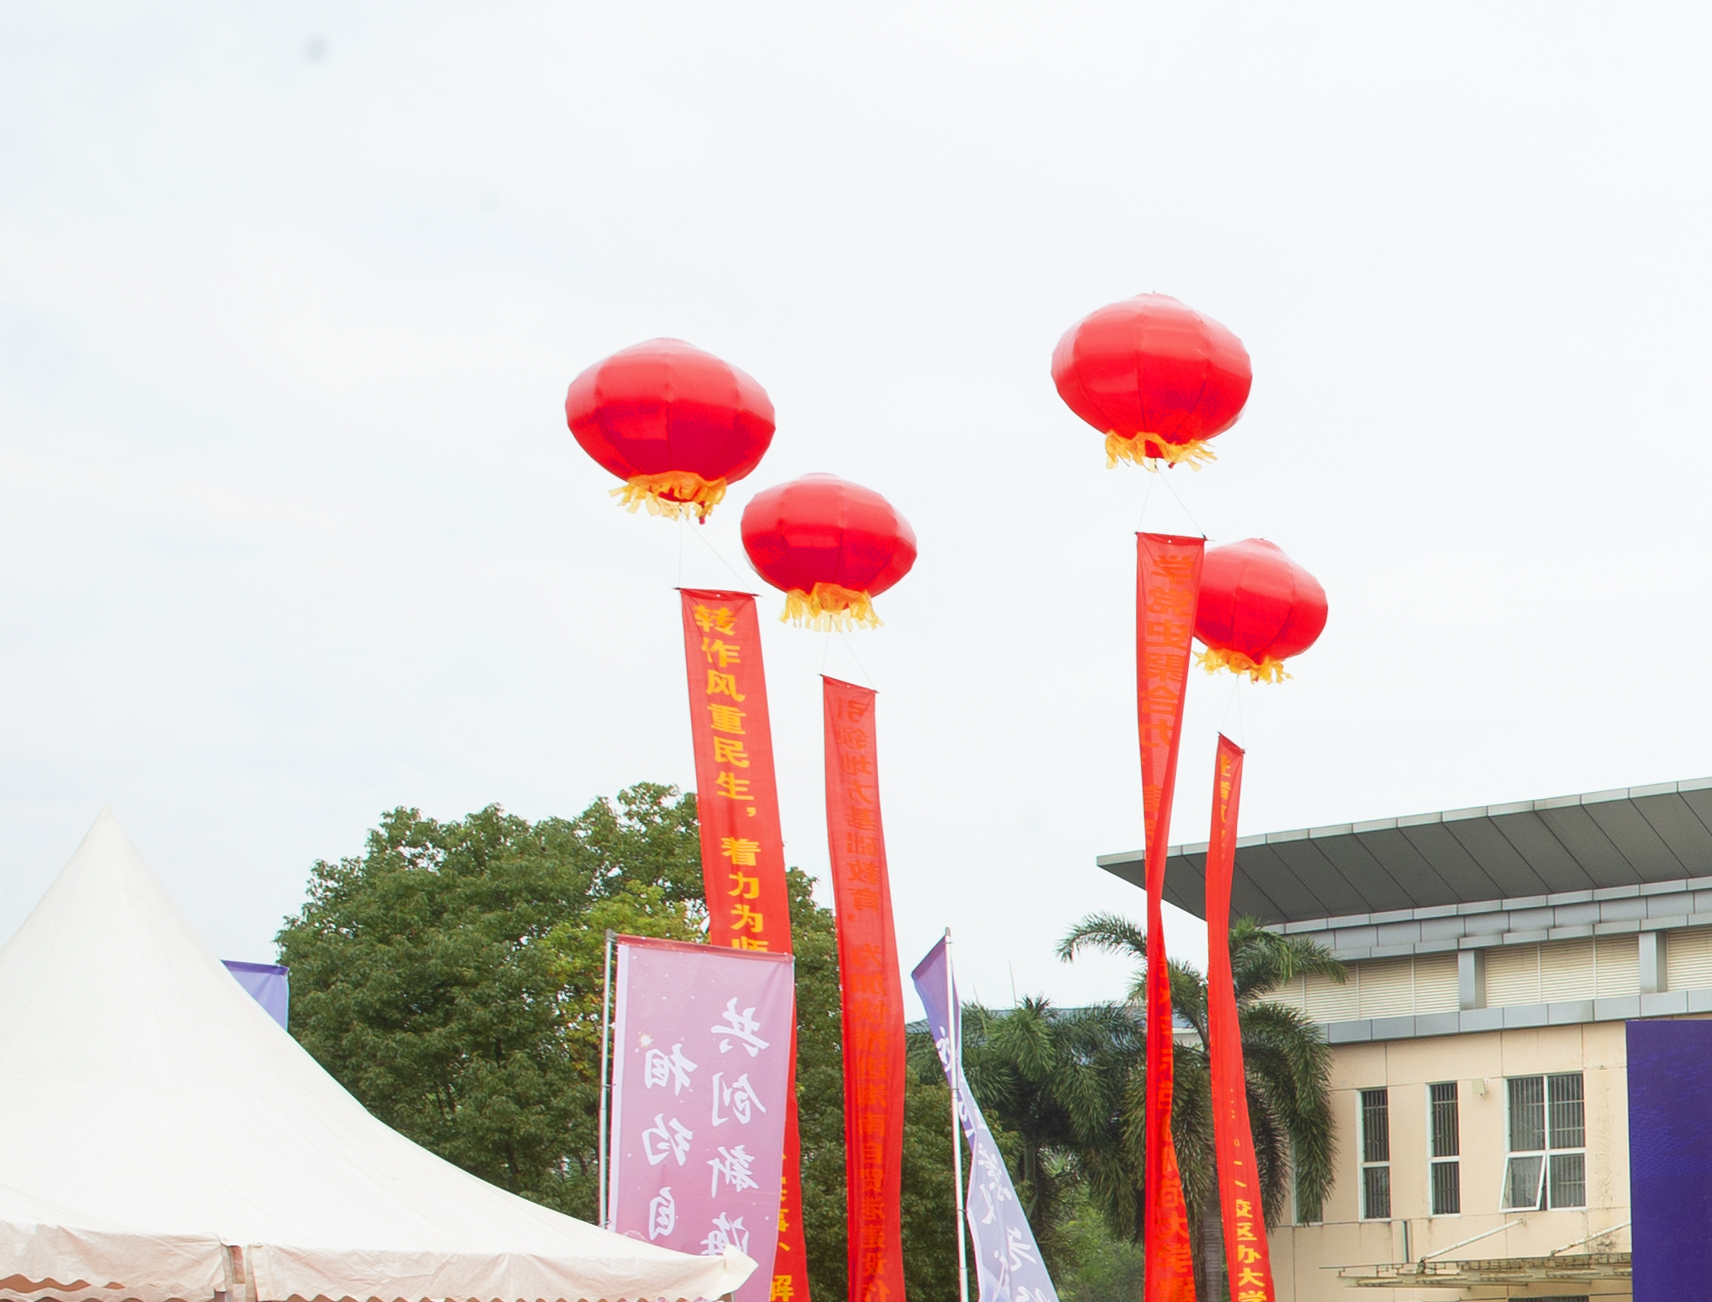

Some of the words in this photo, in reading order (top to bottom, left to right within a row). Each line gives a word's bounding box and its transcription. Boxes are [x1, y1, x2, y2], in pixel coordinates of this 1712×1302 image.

[693, 604, 755, 817] 转作风重民生，
